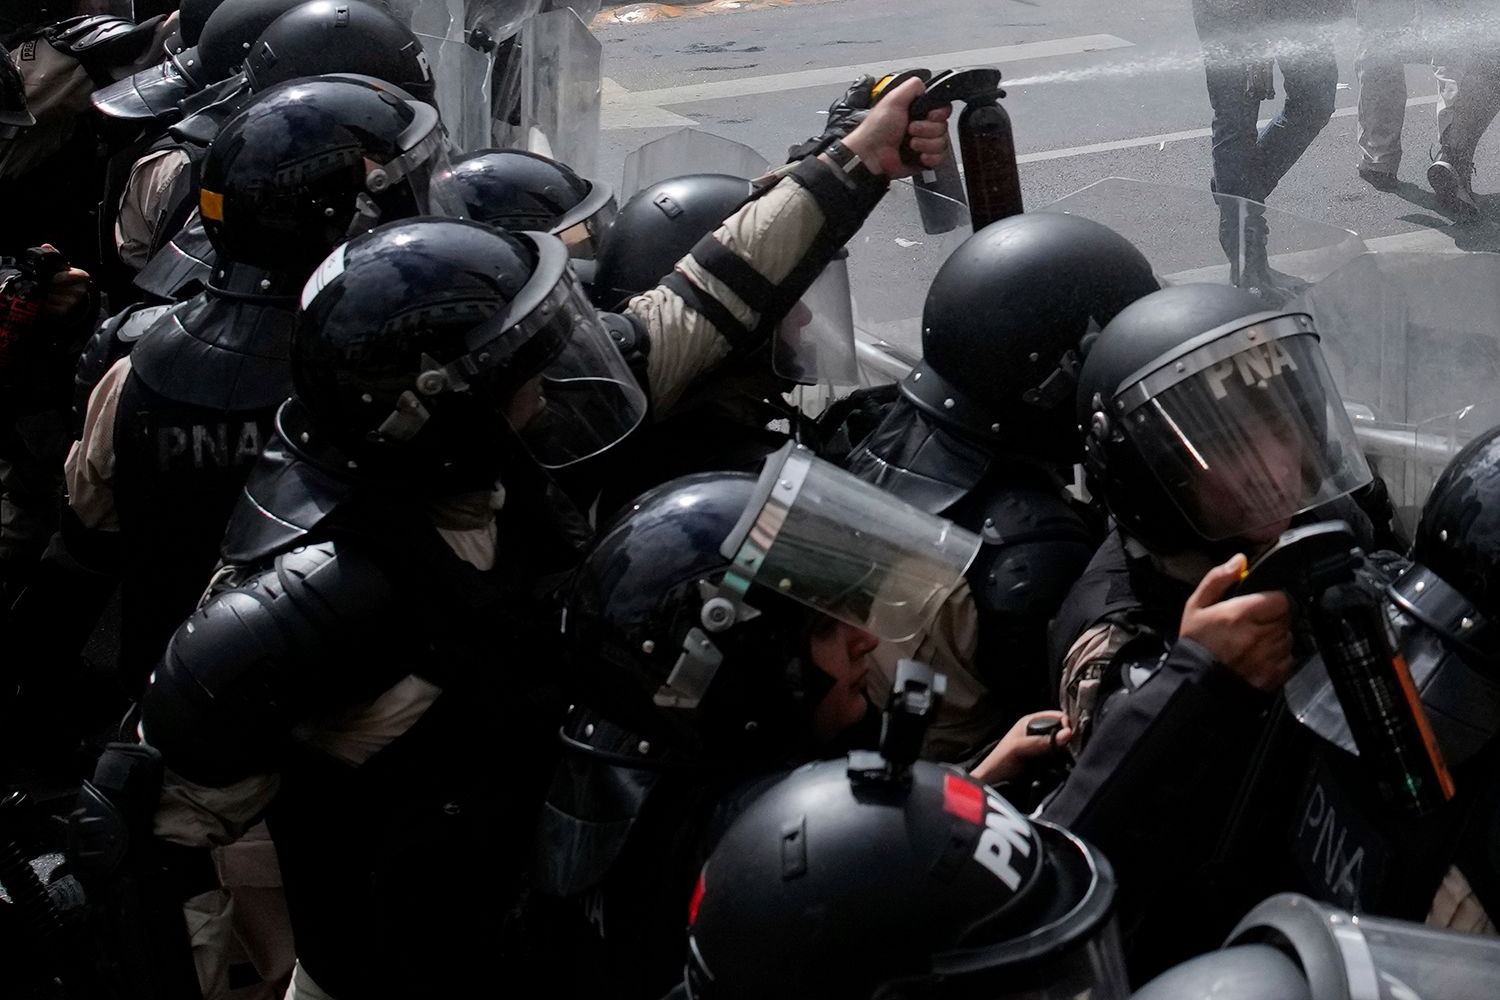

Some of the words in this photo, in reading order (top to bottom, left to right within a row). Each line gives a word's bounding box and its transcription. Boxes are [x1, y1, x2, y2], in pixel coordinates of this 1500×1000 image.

[1204, 341, 1299, 400] PNA
[158, 421, 258, 472] PNA
[1298, 784, 1364, 912] PNA
